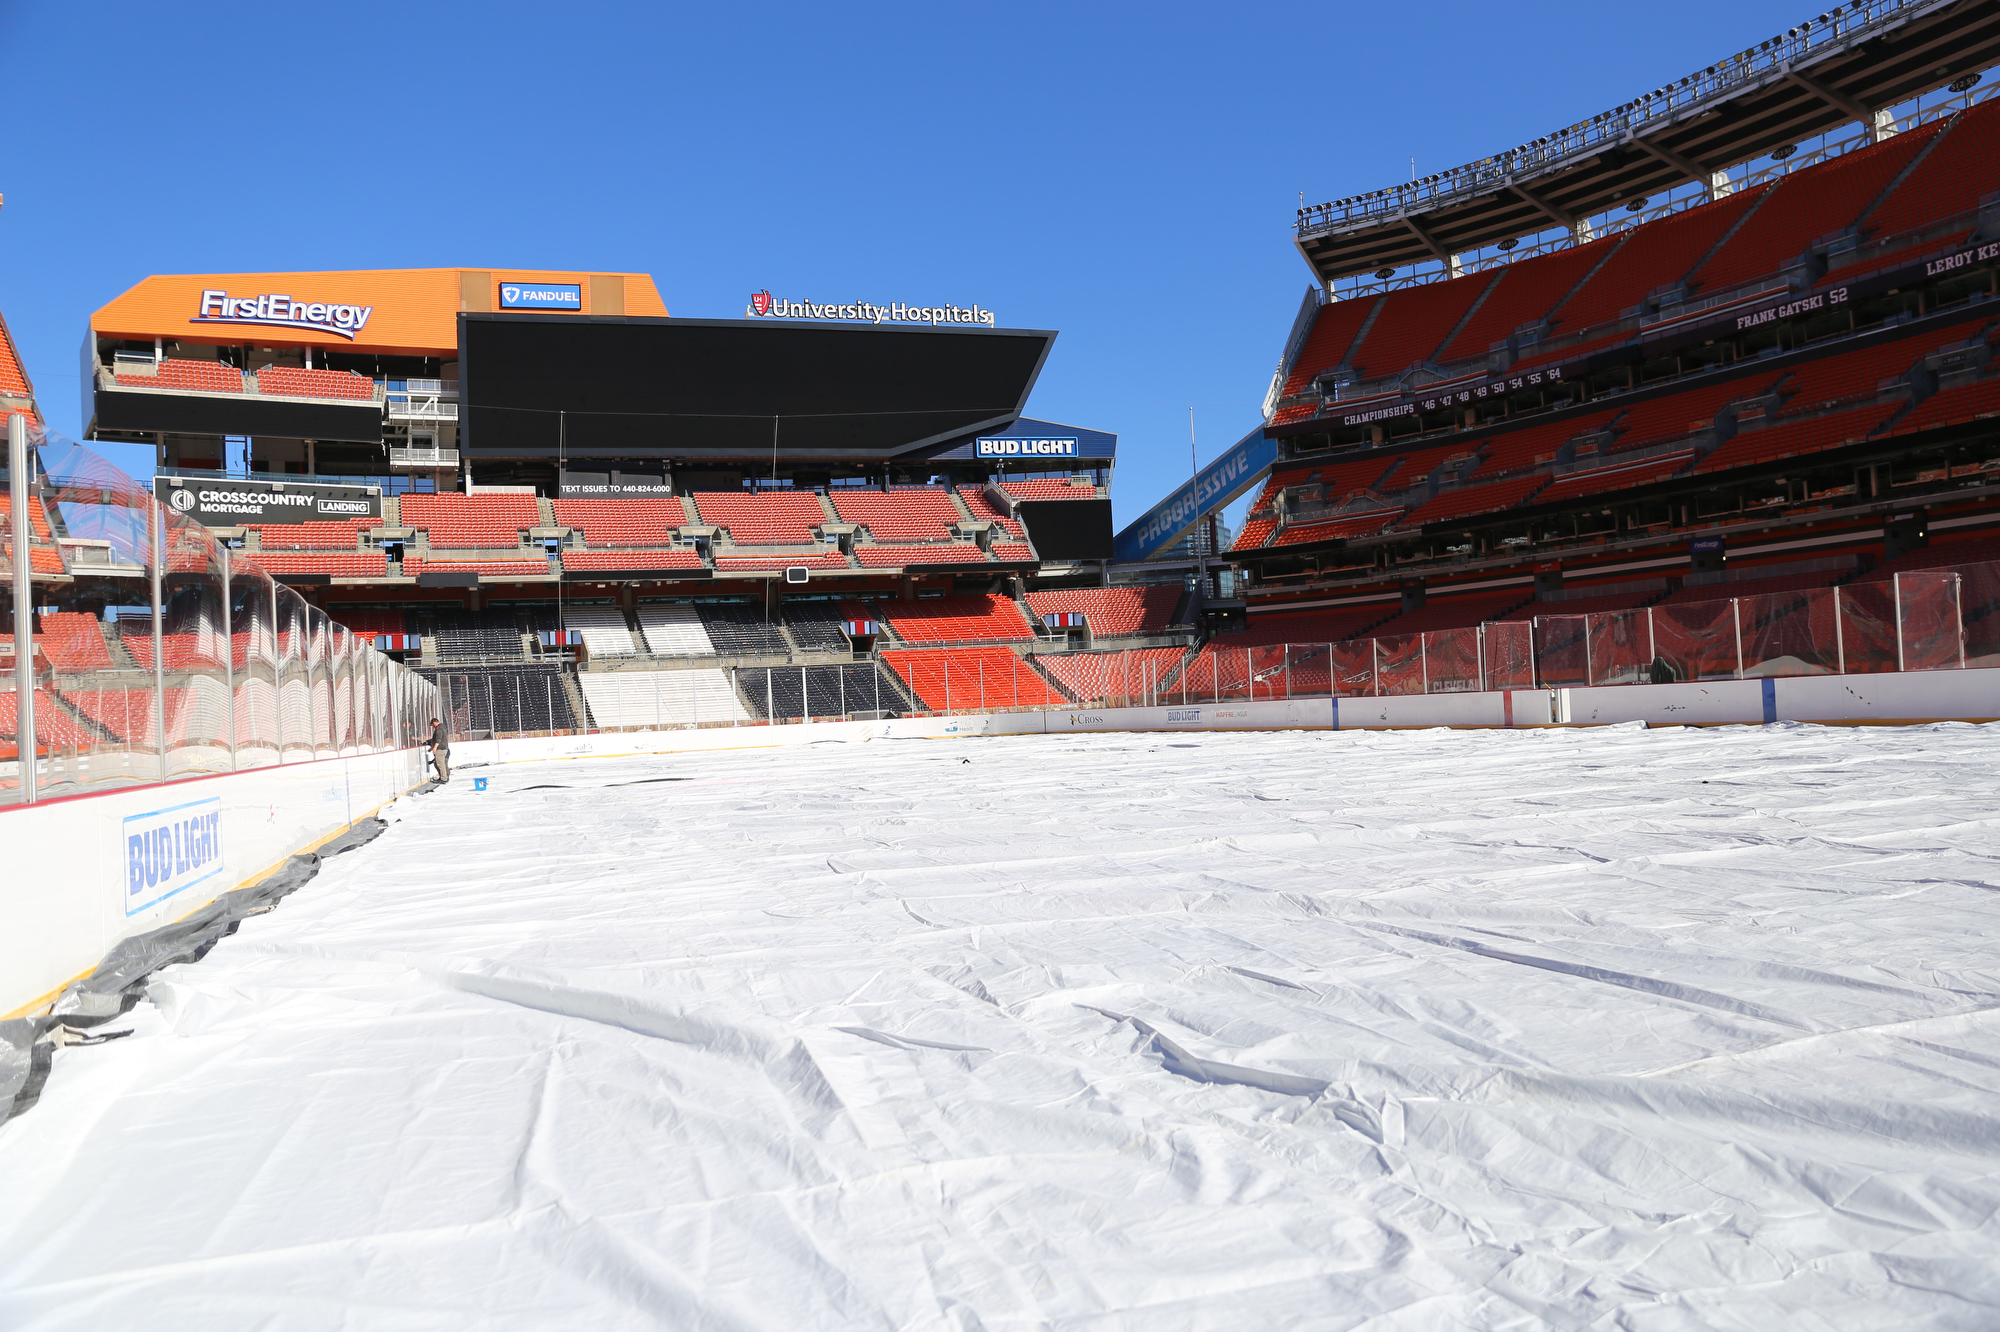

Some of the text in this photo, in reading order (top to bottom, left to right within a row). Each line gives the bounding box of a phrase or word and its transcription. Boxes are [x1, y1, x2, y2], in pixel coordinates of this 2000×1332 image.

[1926, 243, 2000, 276] LEROY KE
[199, 289, 373, 330] FirstEnergy
[522, 290, 580, 302] FANDUEL
[1737, 287, 1848, 330] FRANK GATSKI 52
[772, 298, 990, 326] University Hospitals
[1344, 367, 1561, 426] CHAMPIONSHIPS '46 '47 '48 '49 '50 '54 '55 '64
[980, 440, 1075, 454] BUD LIGHT
[198, 490, 368, 512] CROSSCOUNTRY LANDING
[622, 485, 671, 493] 440-824-6000
[1137, 450, 1249, 549] PROGRESSIVE
[200, 503, 263, 514] MORTGAGE
[1167, 711, 1200, 721] BUD LIGHT
[128, 811, 219, 896] BUD LIGHT
